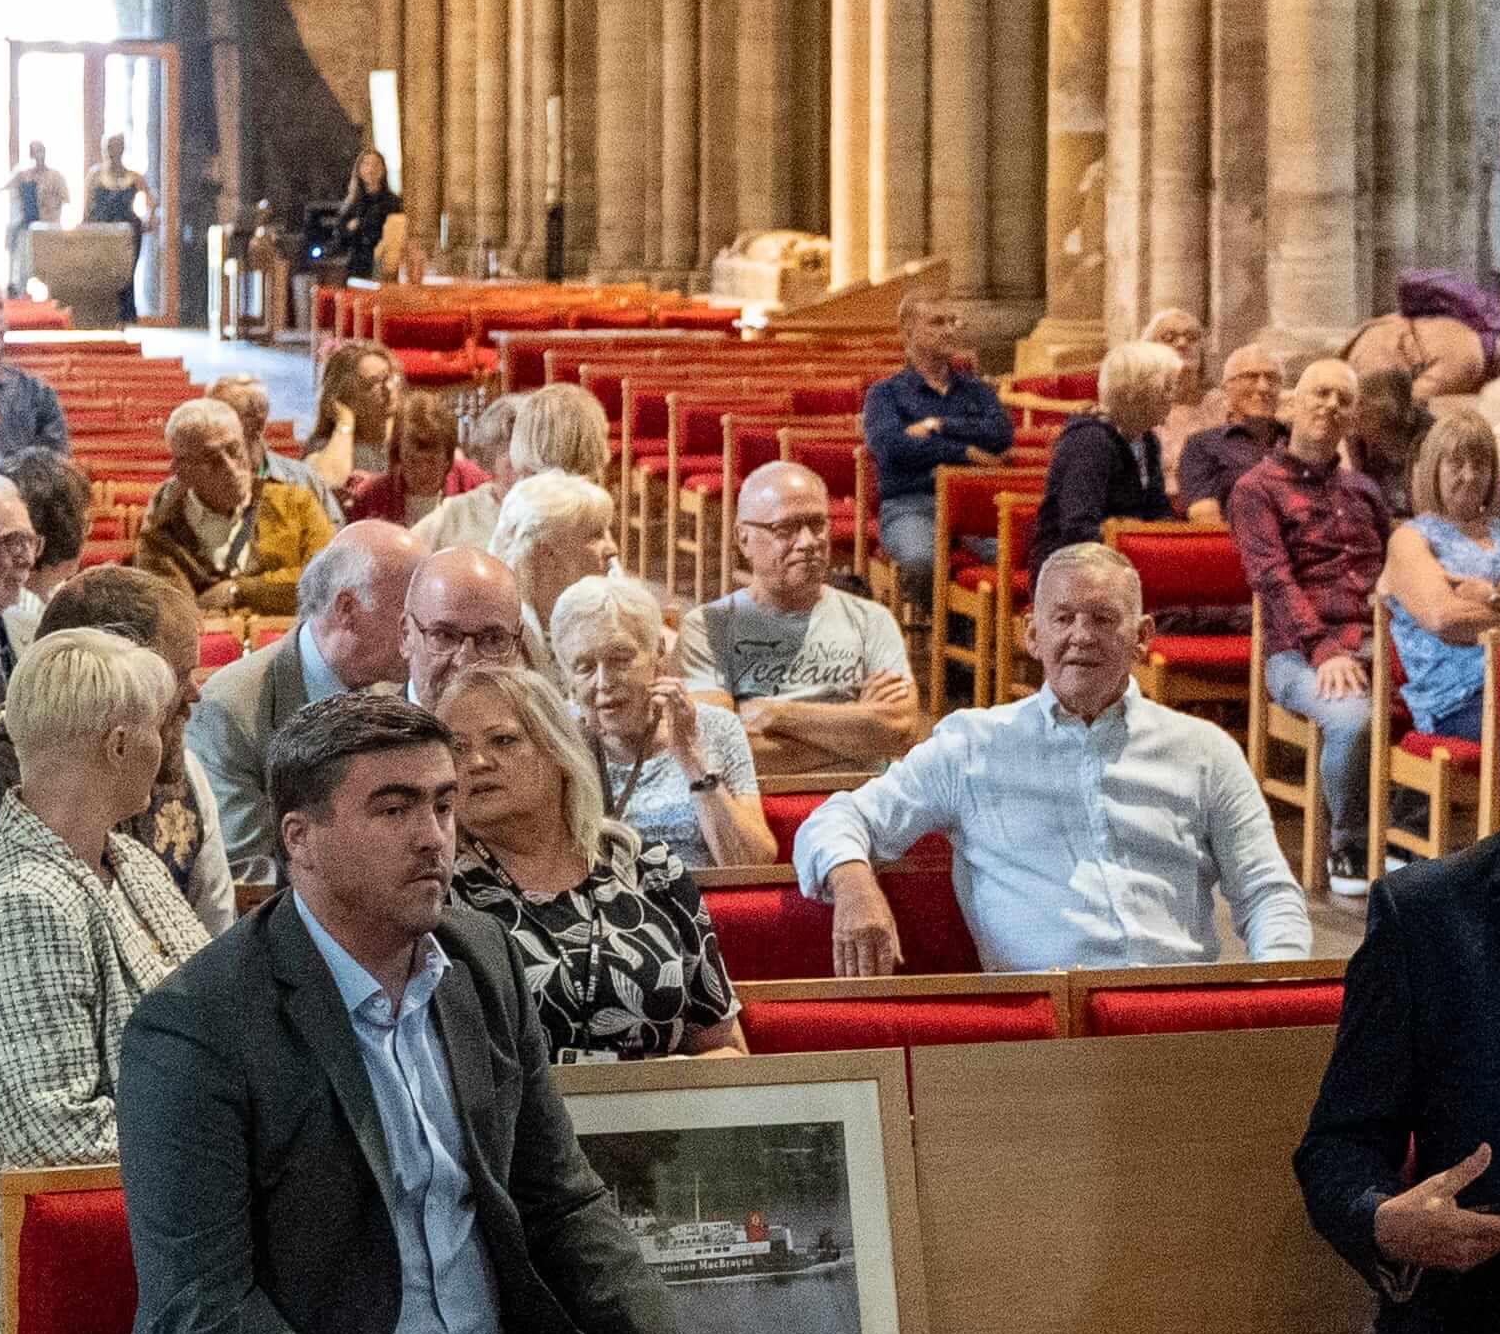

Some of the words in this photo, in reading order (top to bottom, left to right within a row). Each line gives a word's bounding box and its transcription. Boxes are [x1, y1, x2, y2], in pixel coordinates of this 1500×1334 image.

[807, 642, 854, 664] New
[734, 639, 865, 698] Zealand
[586, 974, 599, 1003] STAFF
